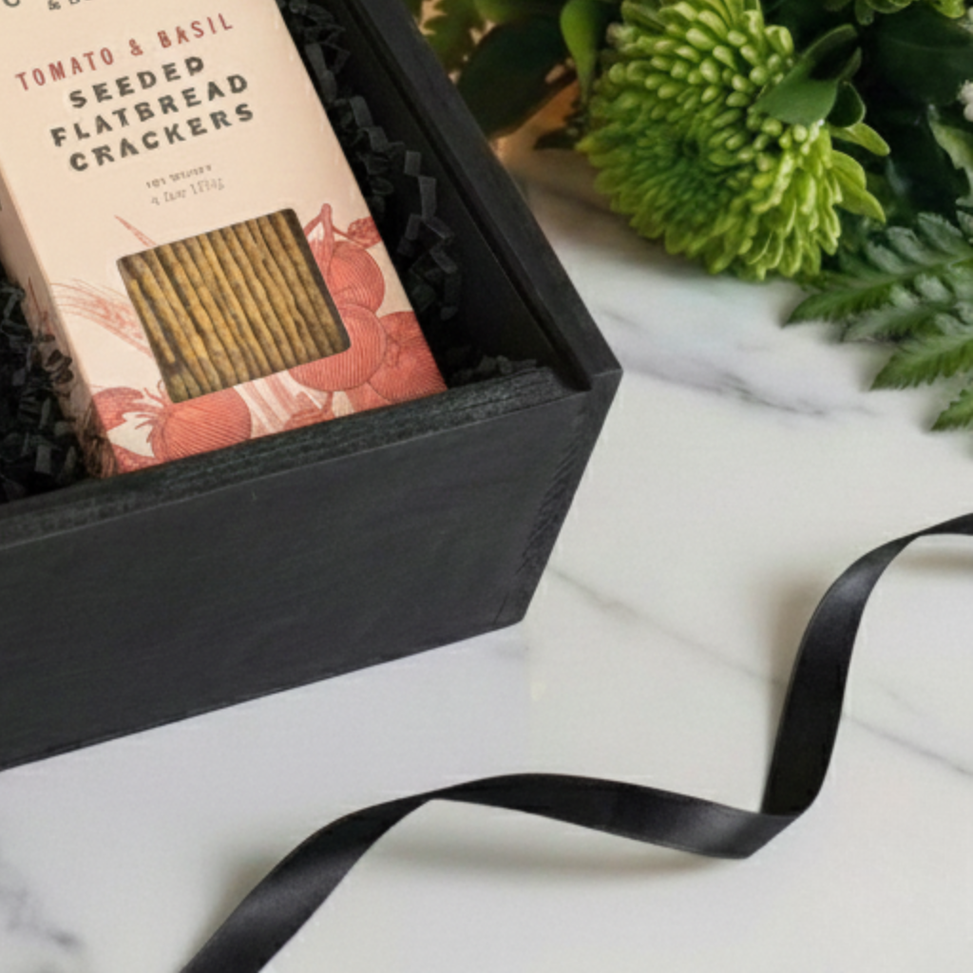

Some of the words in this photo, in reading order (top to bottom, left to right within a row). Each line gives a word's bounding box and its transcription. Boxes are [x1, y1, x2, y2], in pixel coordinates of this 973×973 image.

[14, 47, 115, 92] TOMATO
[128, 38, 144, 57] &
[157, 12, 233, 48] BASIL
[69, 56, 205, 109] SEEDED
[50, 74, 248, 147] FLATBREAD
[69, 103, 254, 171] CRACKERS
